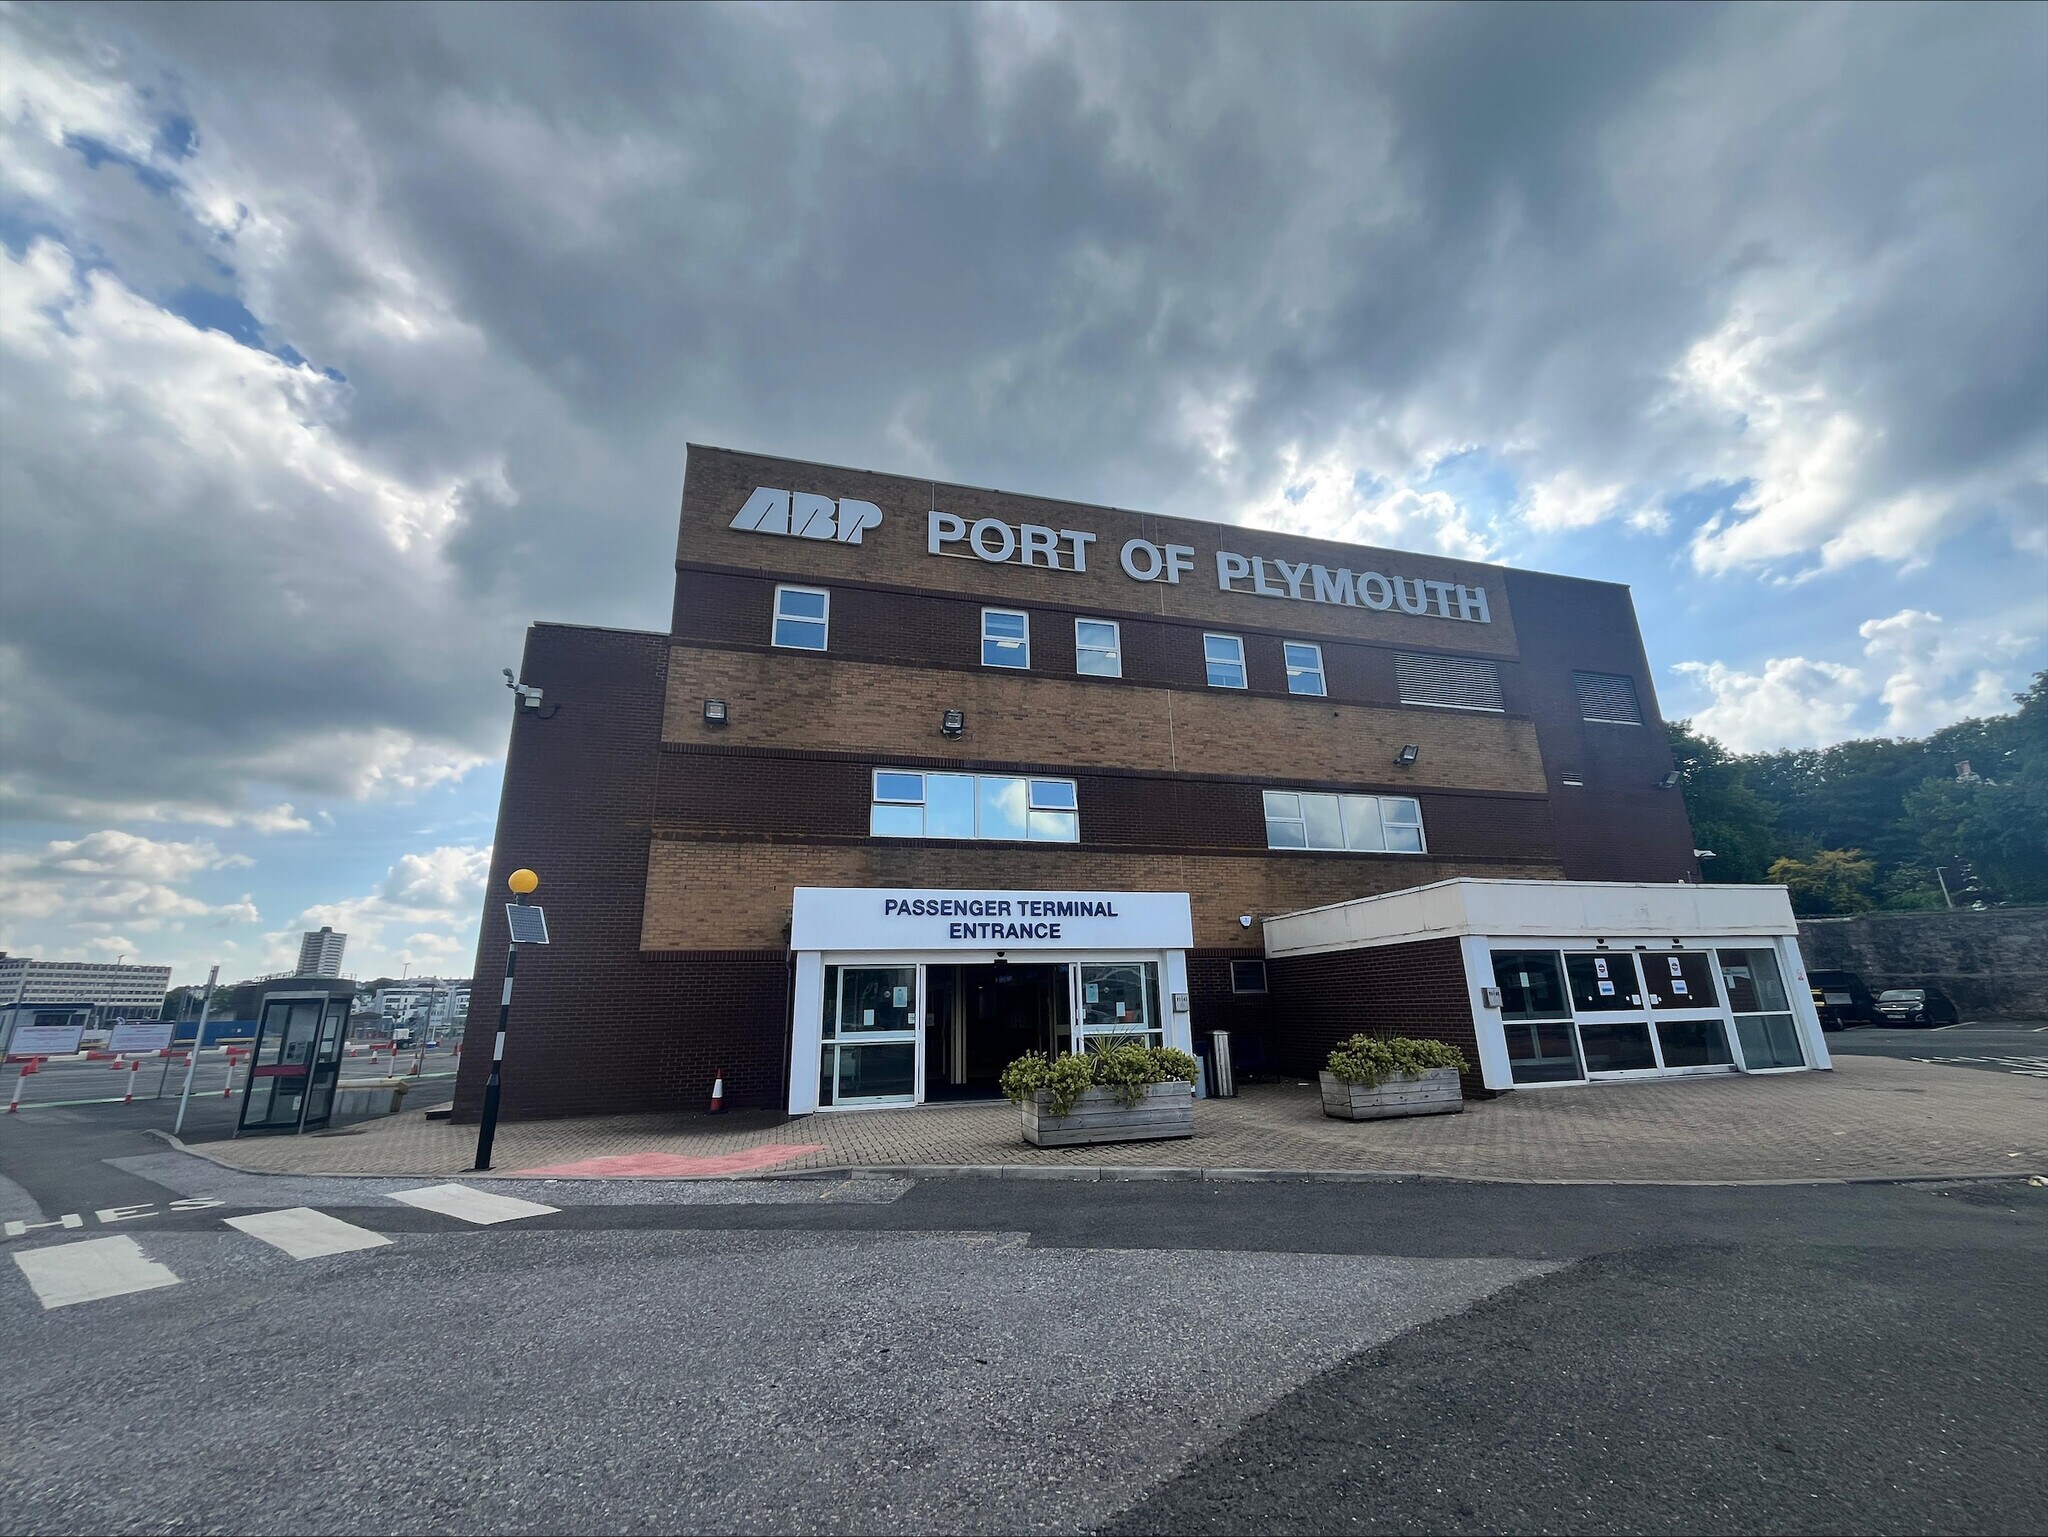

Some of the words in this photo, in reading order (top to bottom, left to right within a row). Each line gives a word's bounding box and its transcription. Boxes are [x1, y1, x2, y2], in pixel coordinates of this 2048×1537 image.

[729, 486, 883, 545] ABP
[928, 510, 1097, 572] PORT
[1120, 538, 1195, 584] OF
[1216, 551, 1491, 624] PLYMOUTH
[885, 899, 1011, 916] PASSENGER
[1017, 900, 1118, 917] TERMINAL
[949, 922, 1061, 939] ENTRANCE
